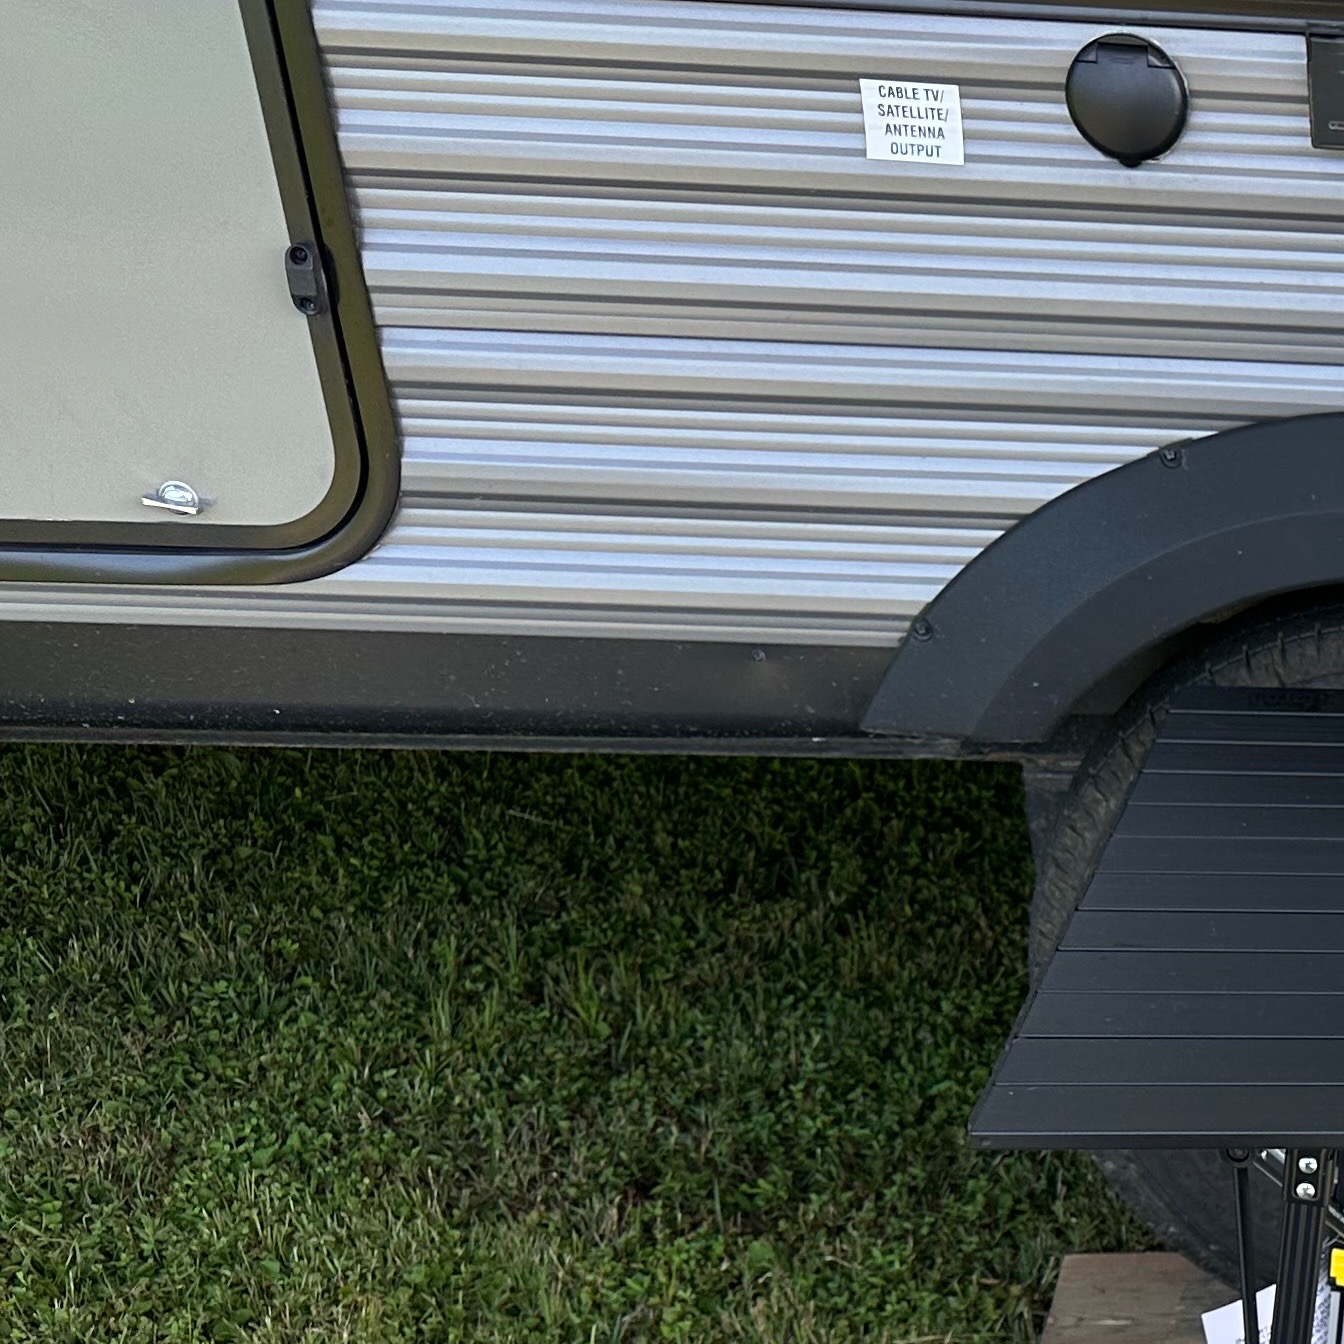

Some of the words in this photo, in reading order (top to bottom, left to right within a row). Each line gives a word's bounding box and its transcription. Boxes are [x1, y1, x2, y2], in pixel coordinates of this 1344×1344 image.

[878, 85, 920, 101] CABLE
[923, 88, 944, 103] TV/
[877, 103, 949, 123] SATELLITE/
[885, 123, 945, 140] ANTENNA
[890, 142, 942, 158] OUTPUT
